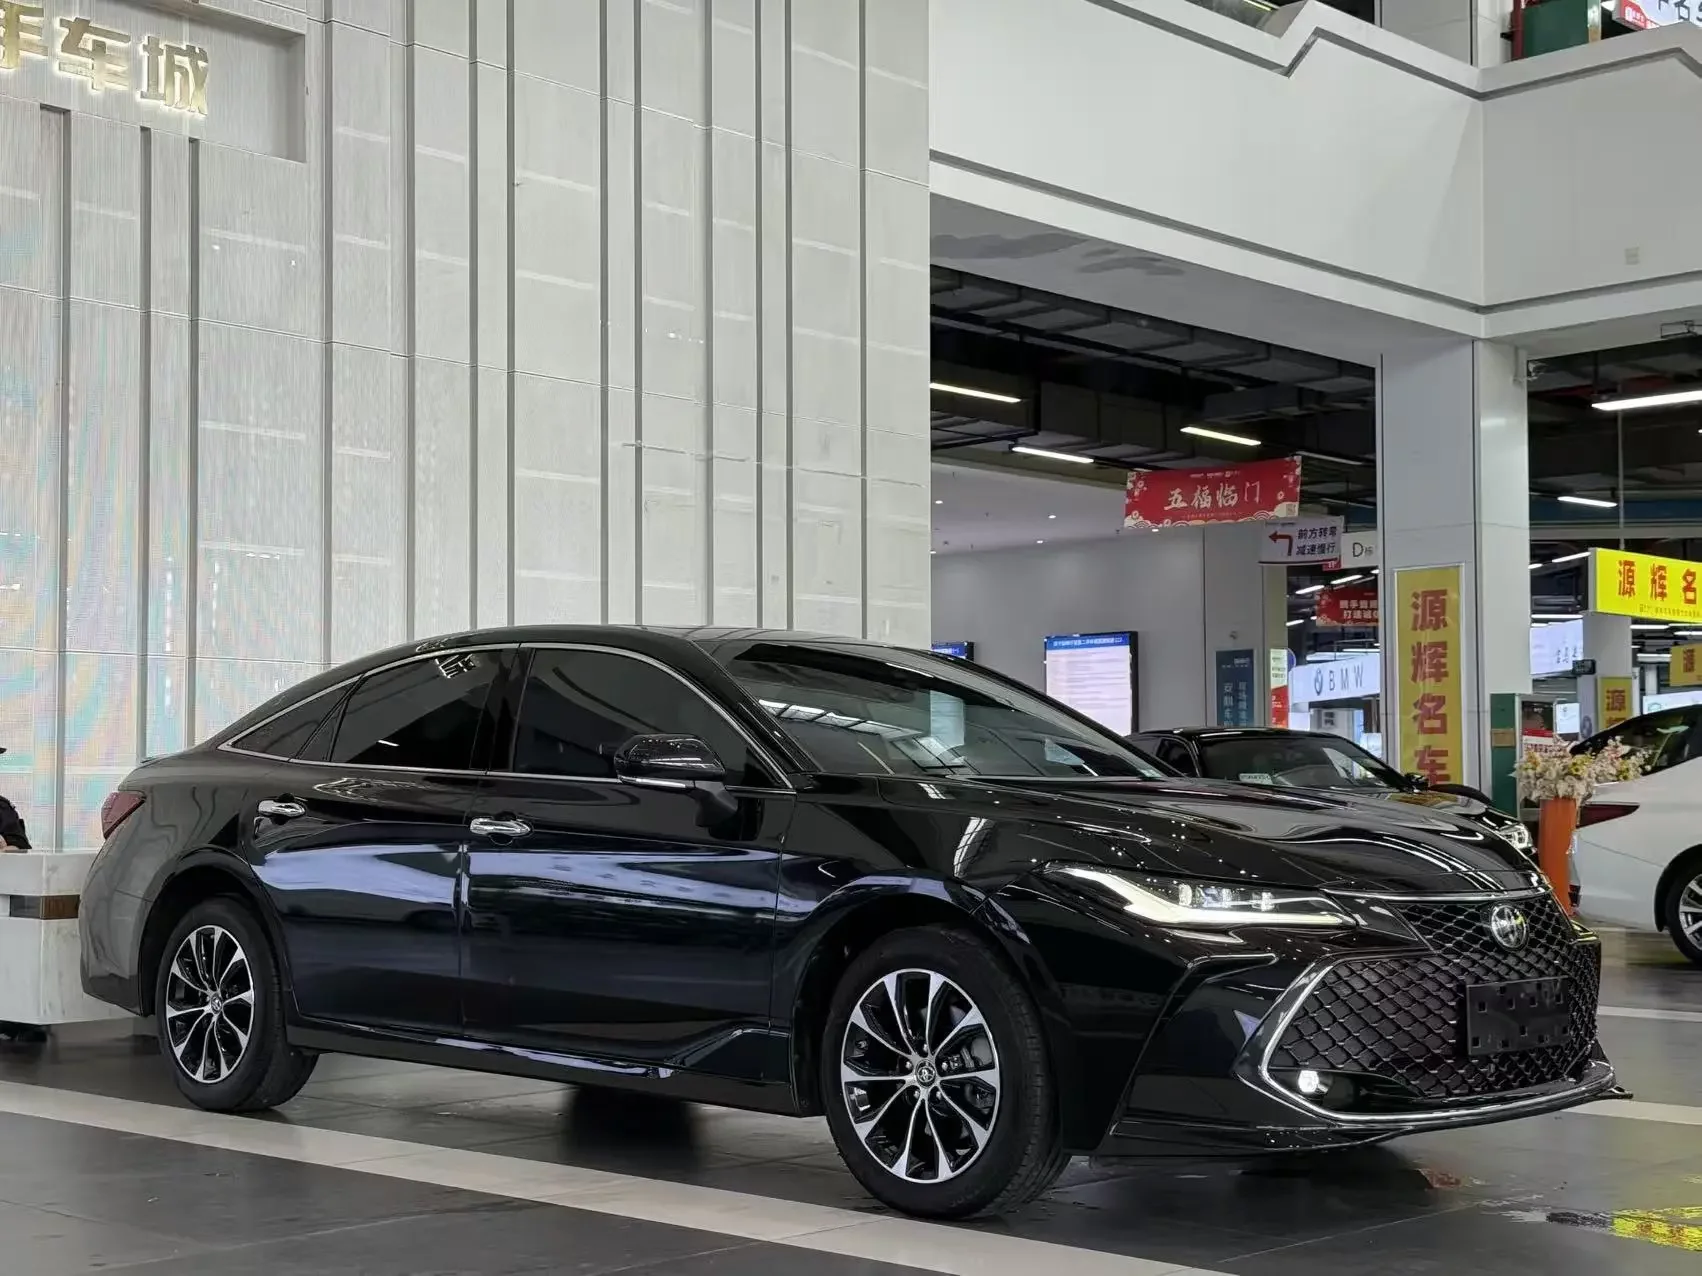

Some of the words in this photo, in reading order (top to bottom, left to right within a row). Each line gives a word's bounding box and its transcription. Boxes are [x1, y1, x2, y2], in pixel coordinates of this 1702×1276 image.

[1163, 480, 1261, 511] 五福临门
[1297, 526, 1337, 540] 前方转弯
[1295, 542, 1336, 556] 减速慢行
[1618, 559, 1697, 605] 源辉名
[1328, 662, 1364, 691] BMW
[1410, 588, 1450, 785] 源辉名车
